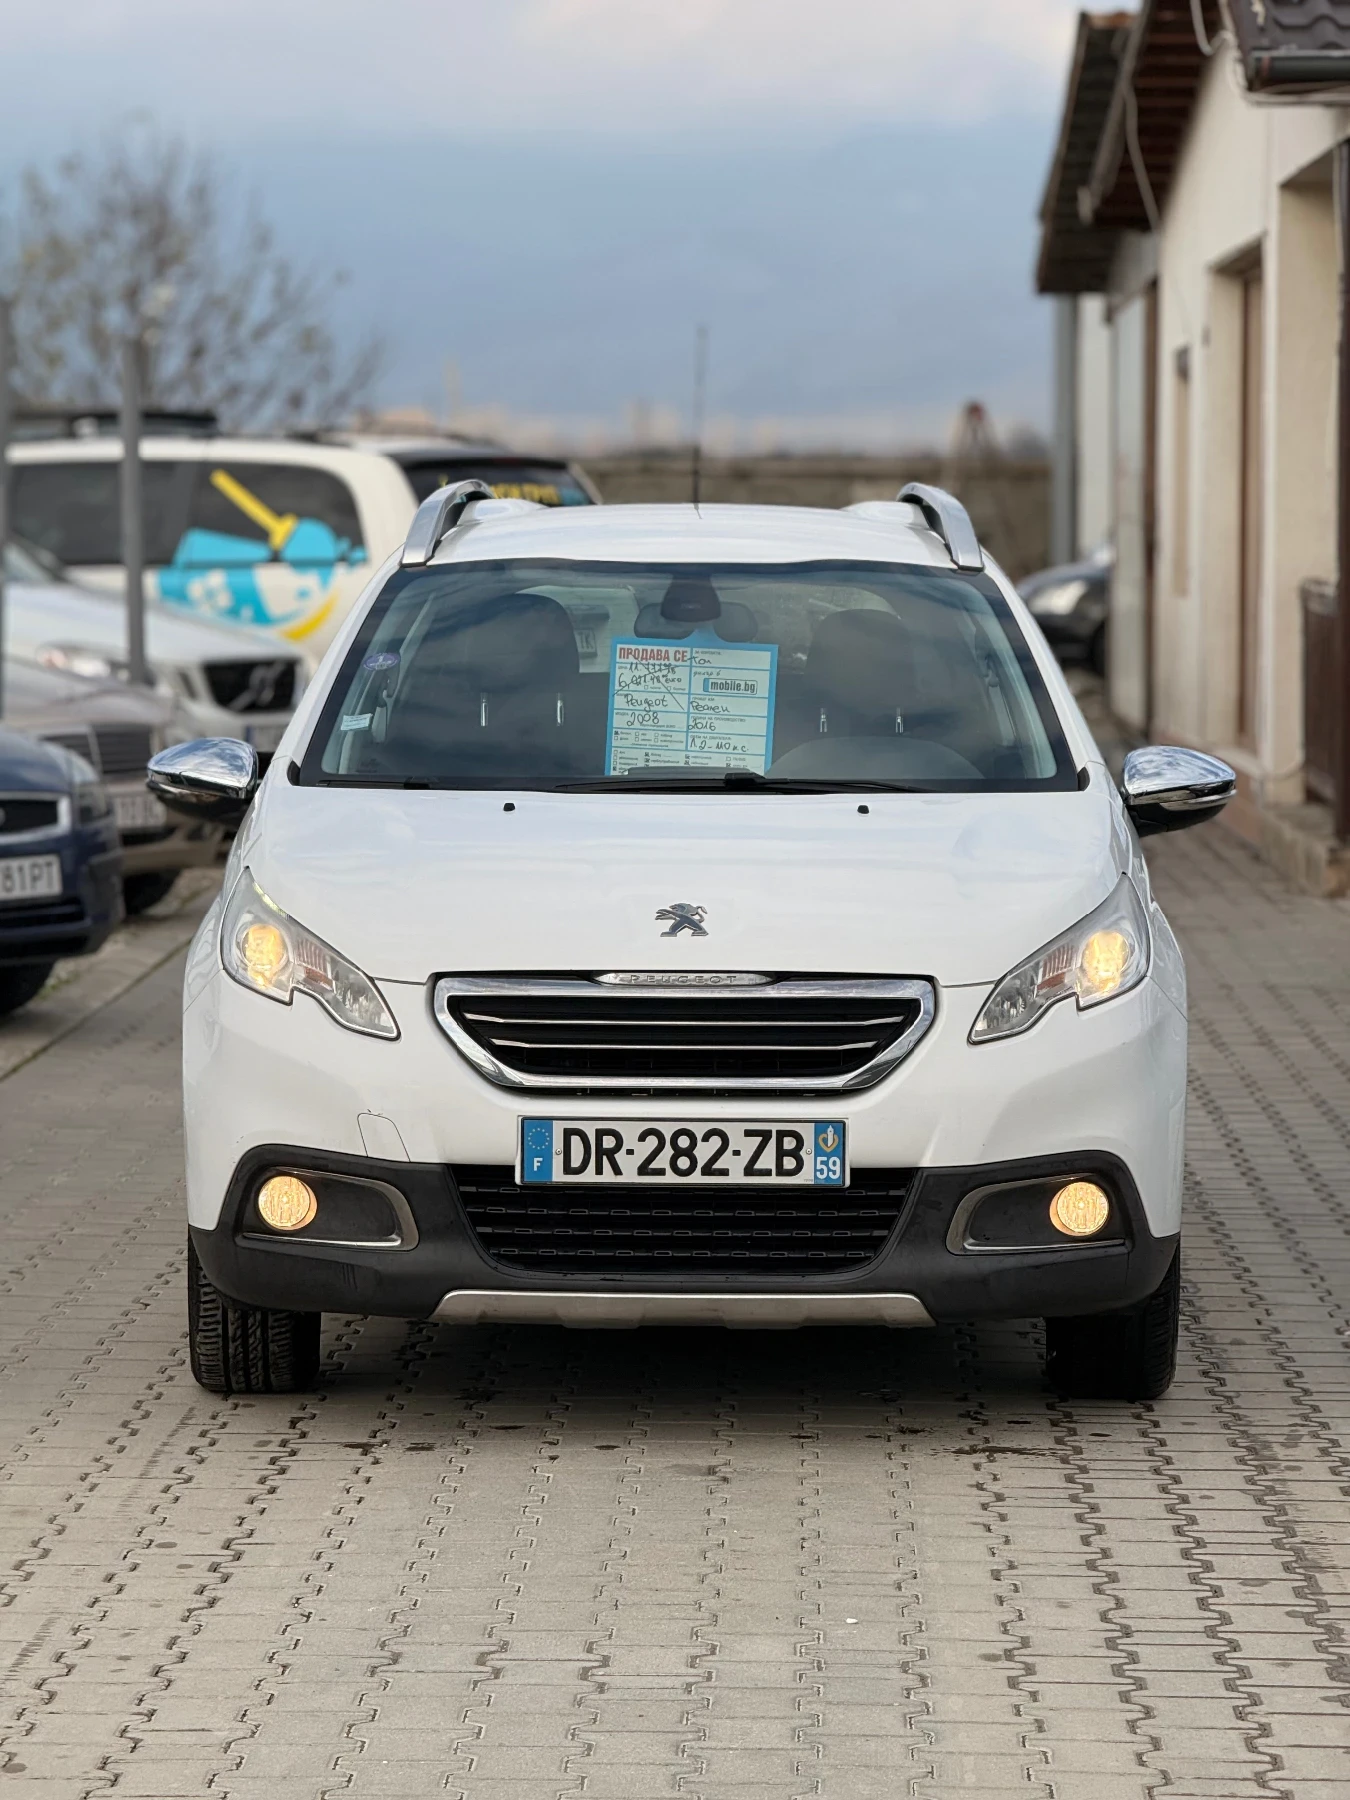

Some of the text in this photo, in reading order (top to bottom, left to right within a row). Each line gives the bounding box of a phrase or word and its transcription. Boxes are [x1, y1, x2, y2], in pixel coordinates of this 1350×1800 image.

[618, 647, 688, 663] ПРОДАВА СЕ
[710, 680, 756, 694] mobile.bg
[624, 693, 669, 713] Peugeot
[626, 711, 659, 727] 2008
[687, 718, 717, 731] 2016
[629, 973, 738, 984] PEUGEOT
[562, 1127, 805, 1178] DR-282-ZB
[533, 1158, 544, 1172] F
[816, 1156, 841, 1180] 59
